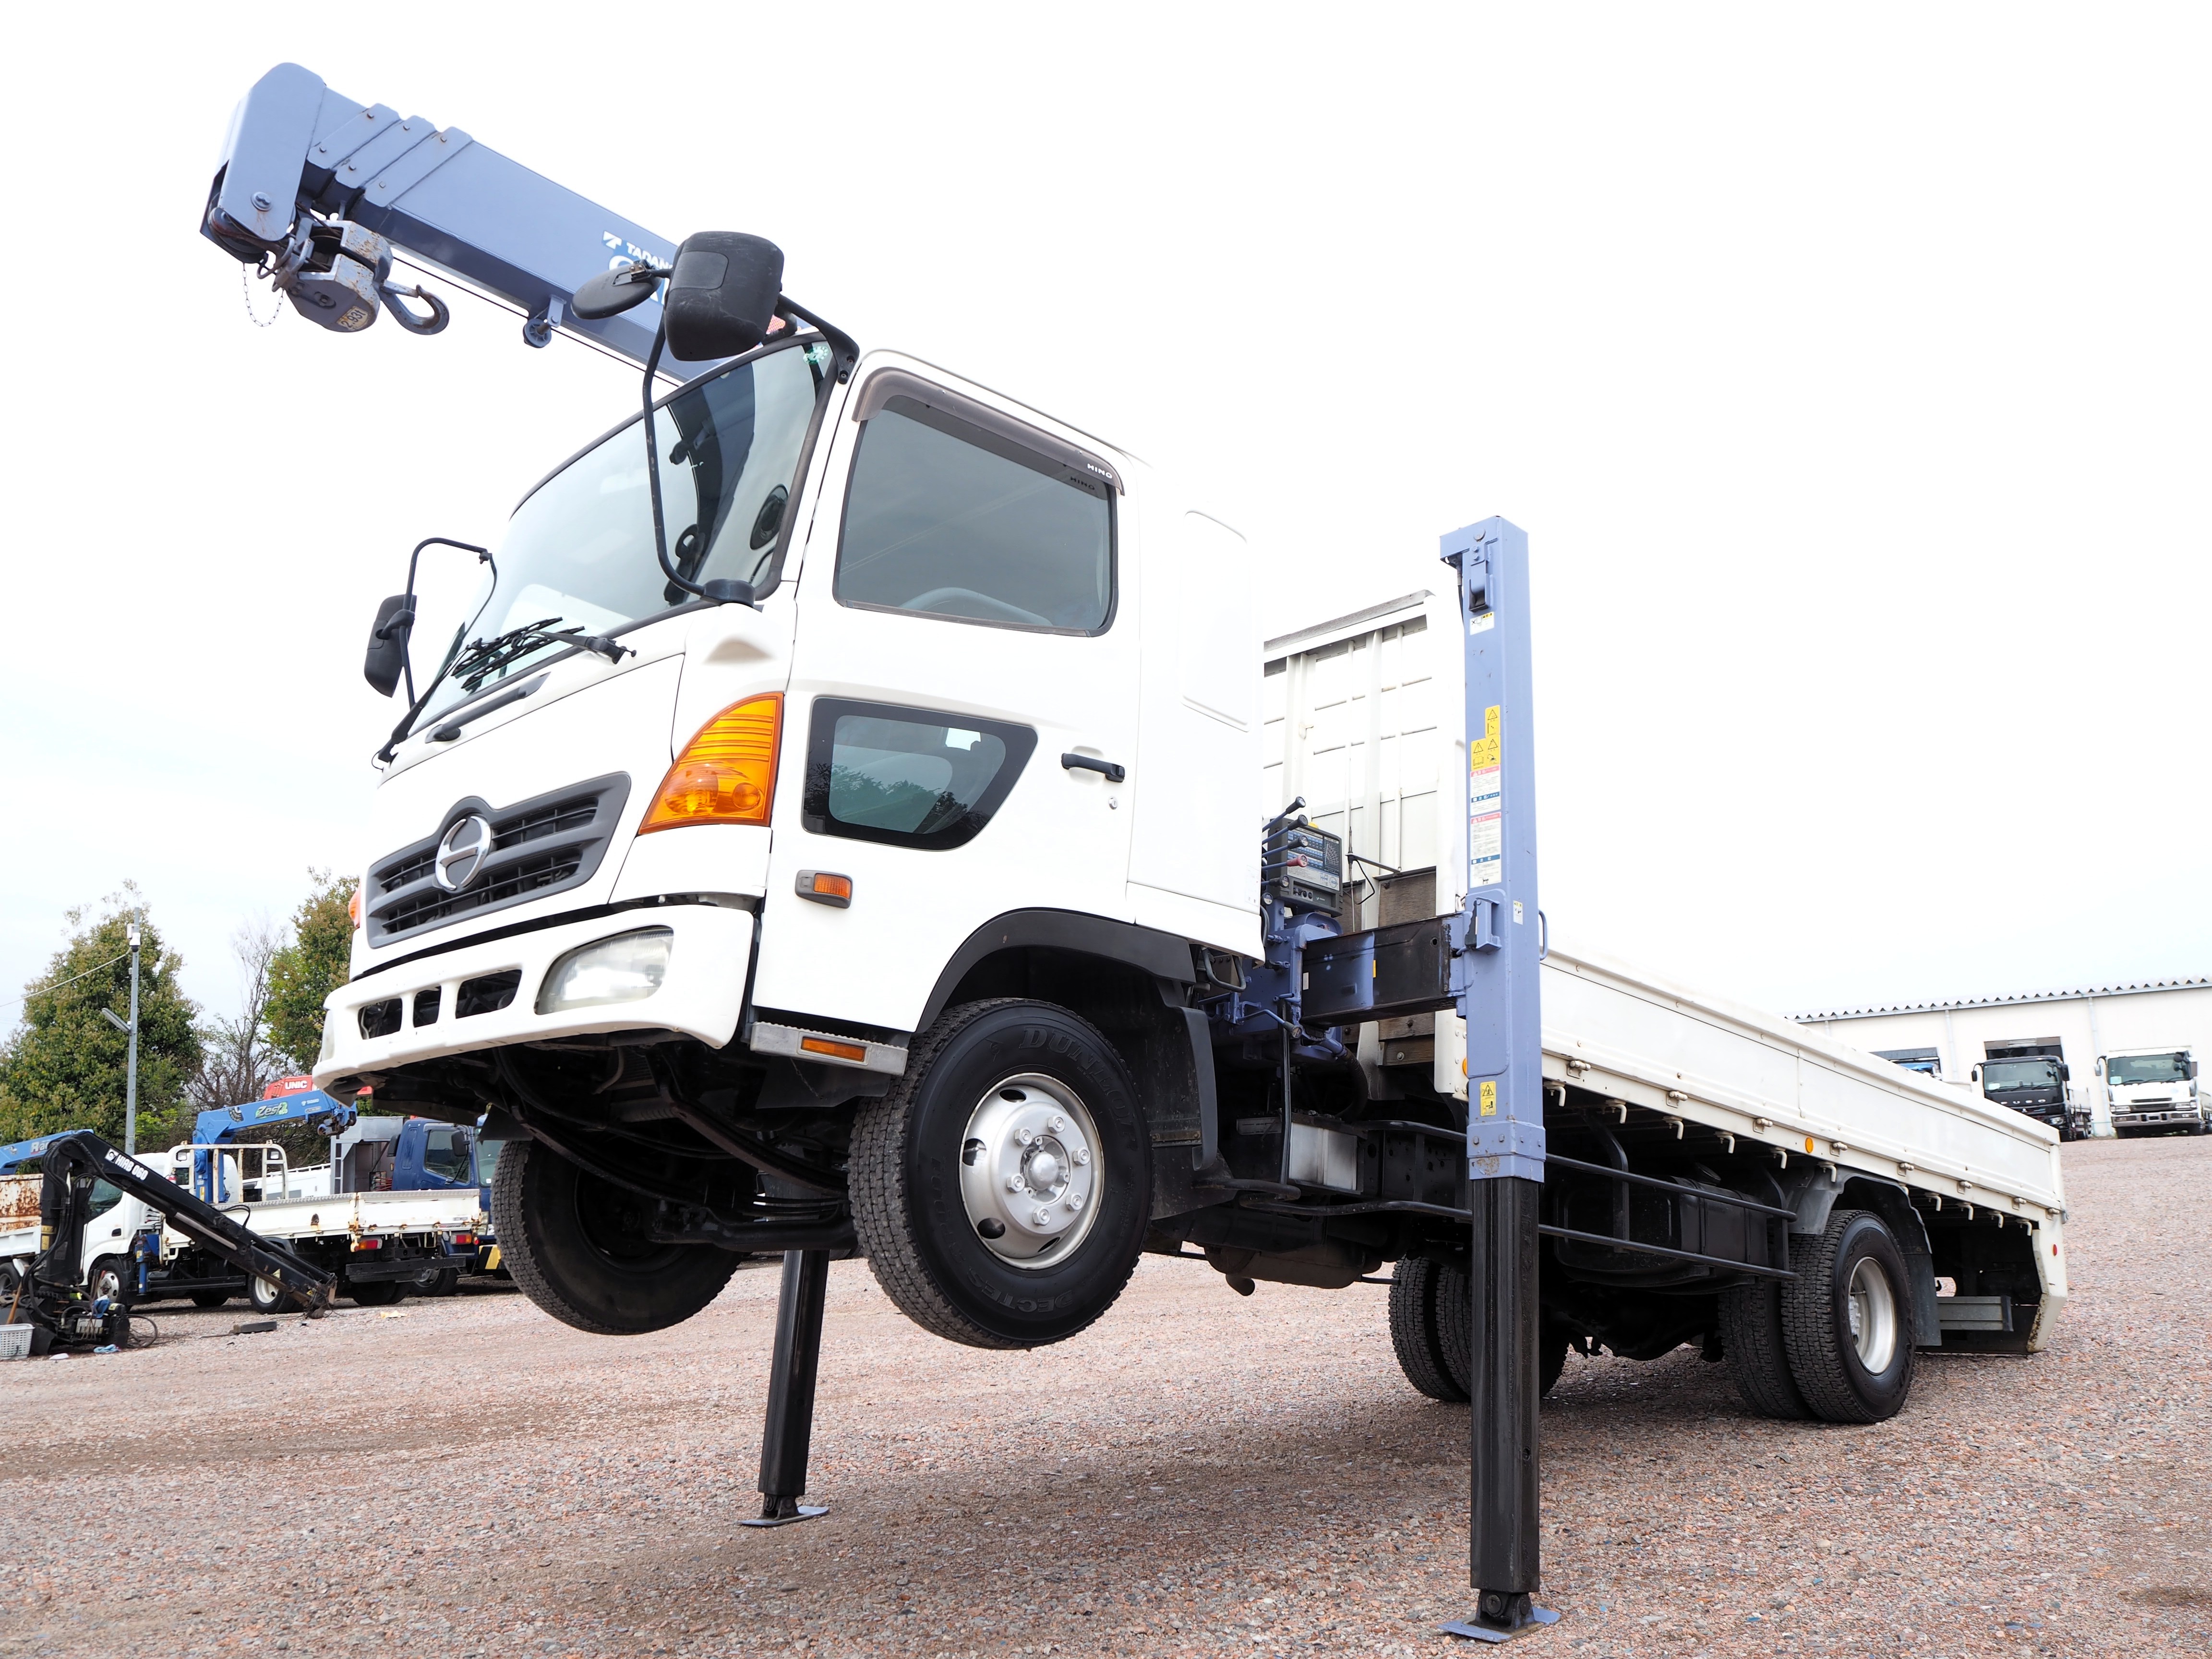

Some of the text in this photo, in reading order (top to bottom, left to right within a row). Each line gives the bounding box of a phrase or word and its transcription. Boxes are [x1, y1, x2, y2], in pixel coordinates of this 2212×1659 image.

[626, 241, 673, 270] TADAN
[341, 309, 366, 328] 2.93t
[1087, 463, 1113, 479] HINO
[1070, 476, 1095, 490] HINO
[285, 1080, 308, 1090] UNIC
[1019, 1025, 1138, 1152] DUNLOP
[255, 1102, 283, 1118] Zest
[114, 1154, 149, 1180] HIAB 060
[966, 1268, 1072, 1314] DECTES
